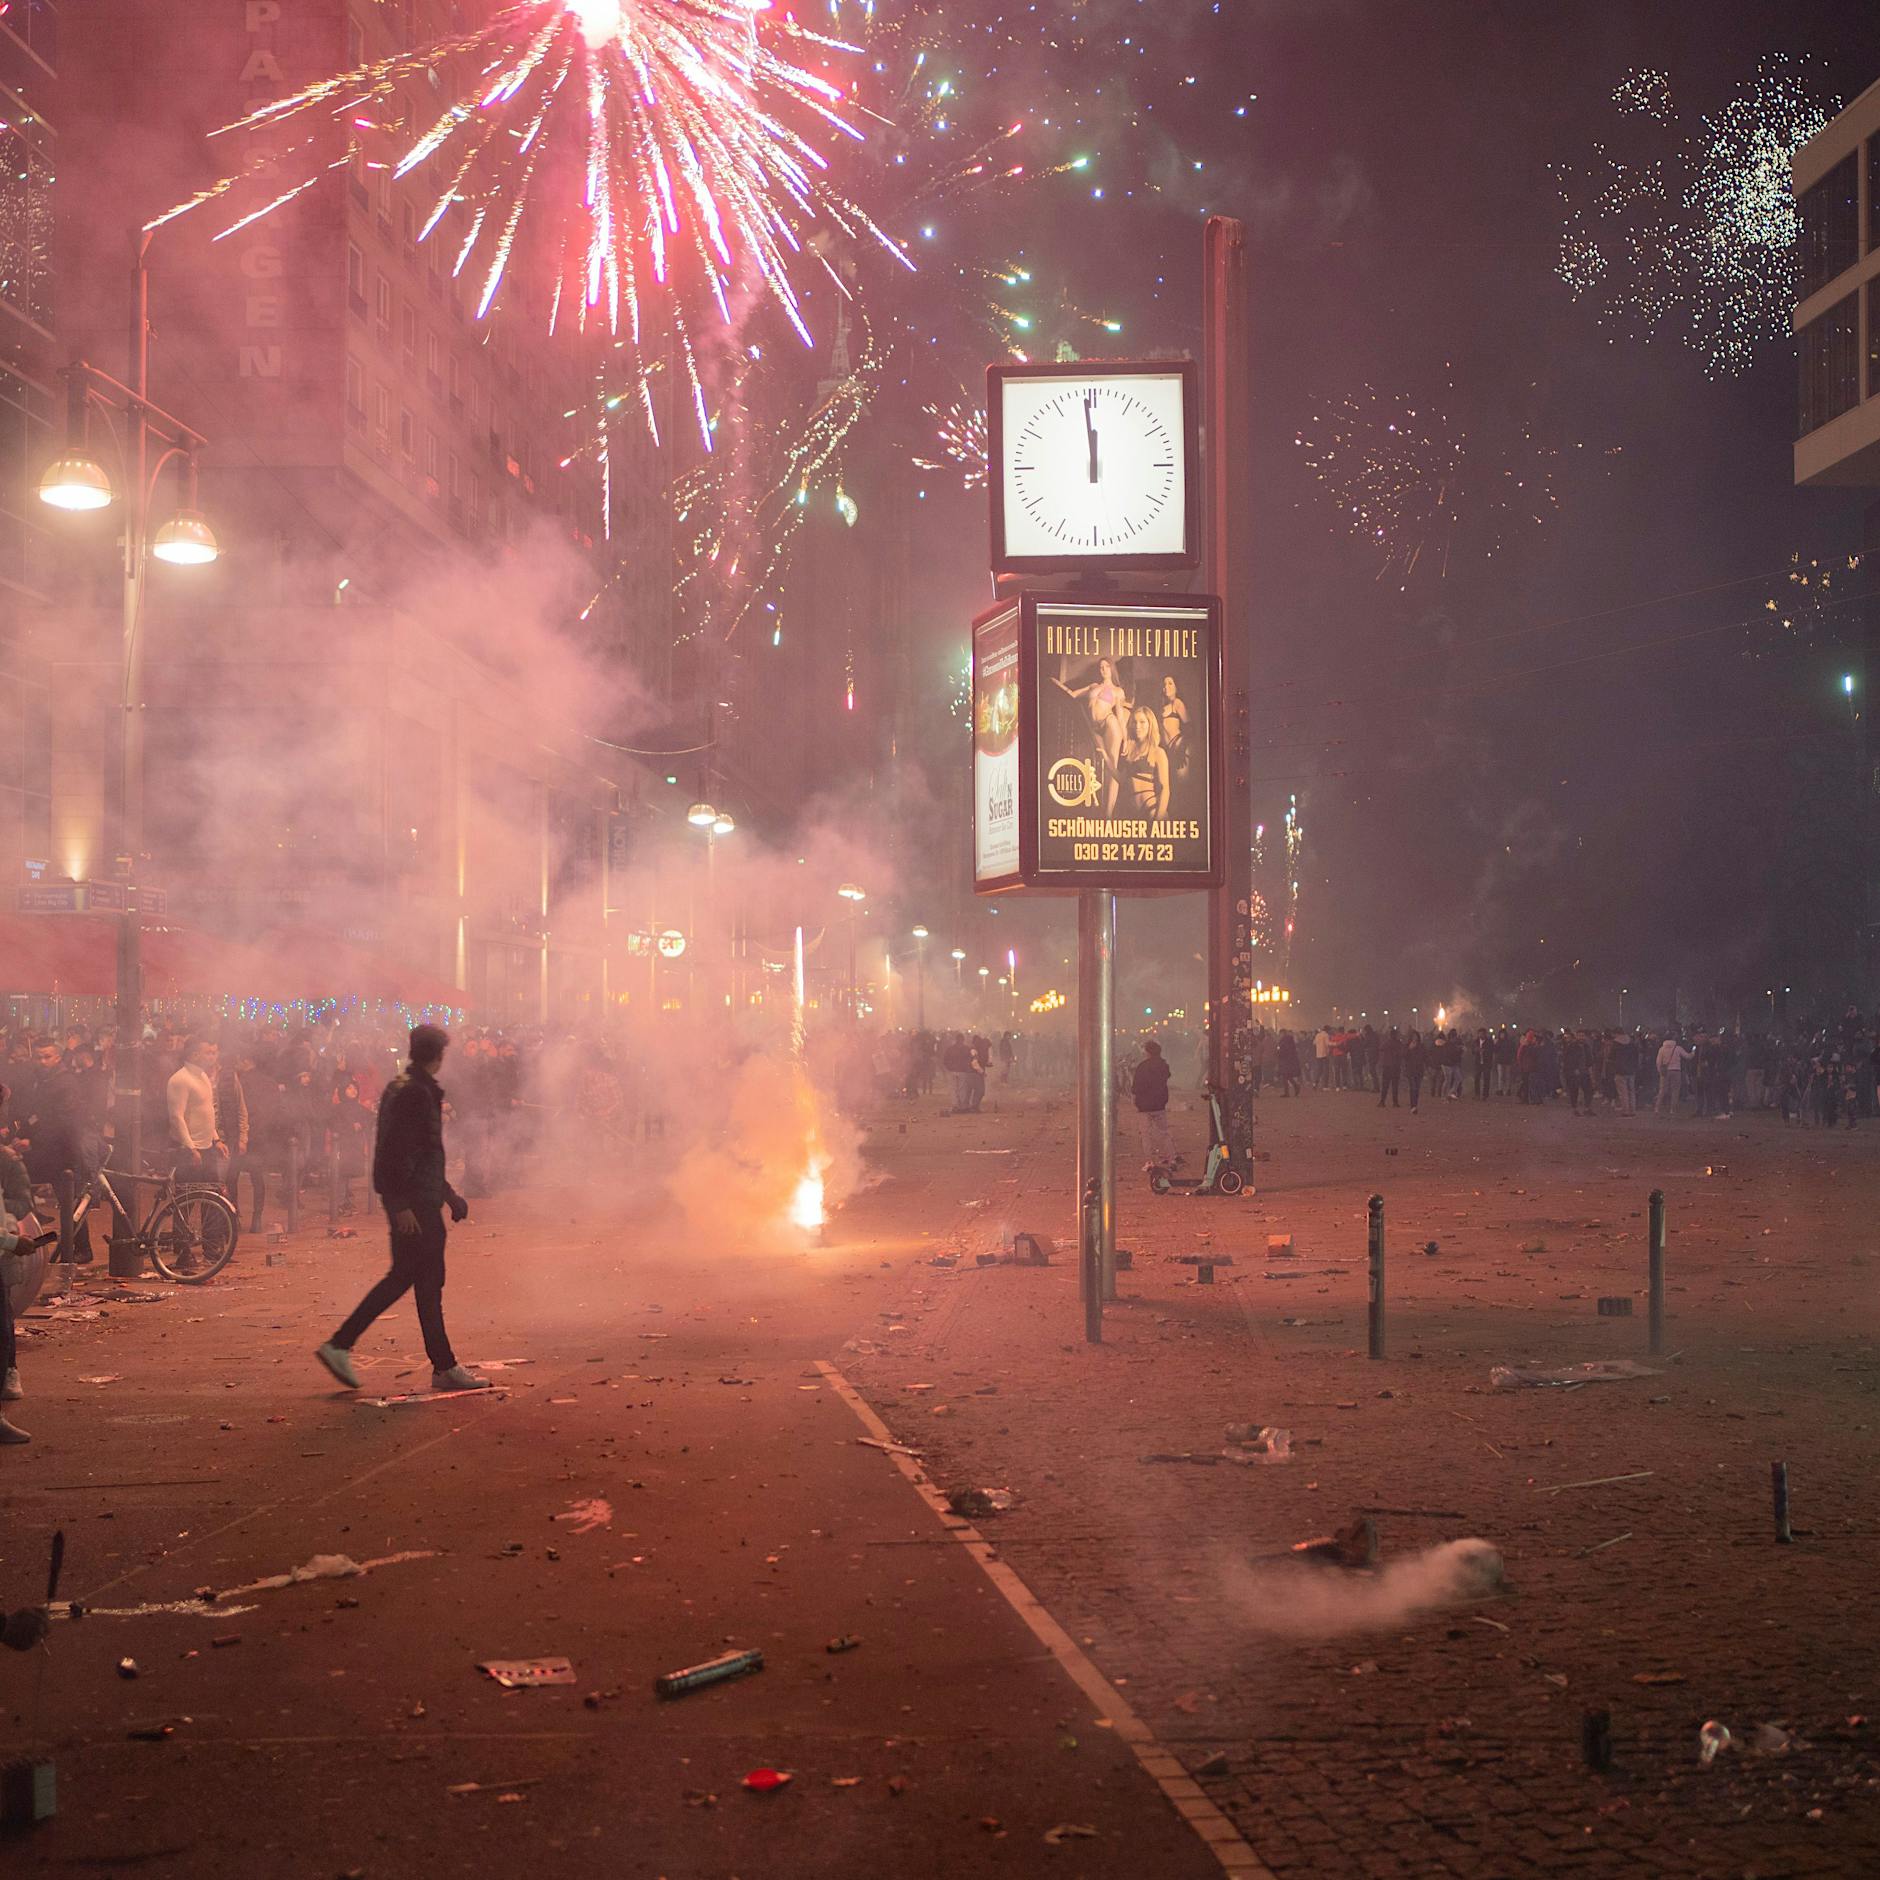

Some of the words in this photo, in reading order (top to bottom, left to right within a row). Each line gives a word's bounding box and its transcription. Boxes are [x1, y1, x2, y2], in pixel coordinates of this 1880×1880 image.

[1047, 626, 1100, 656] ANGELS
[1109, 627, 1198, 658] TABLEDANCE
[1056, 773, 1083, 792] ANGELS
[1048, 816, 1148, 839] SCHÖNHAUSER
[1151, 820, 1187, 839] ALLEE
[1190, 821, 1199, 839] 5
[1074, 843, 1099, 861] 030
[1102, 843, 1119, 861] 92
[1121, 844, 1136, 861] 14
[1138, 844, 1153, 862] 76
[1156, 844, 1174, 862] 23
